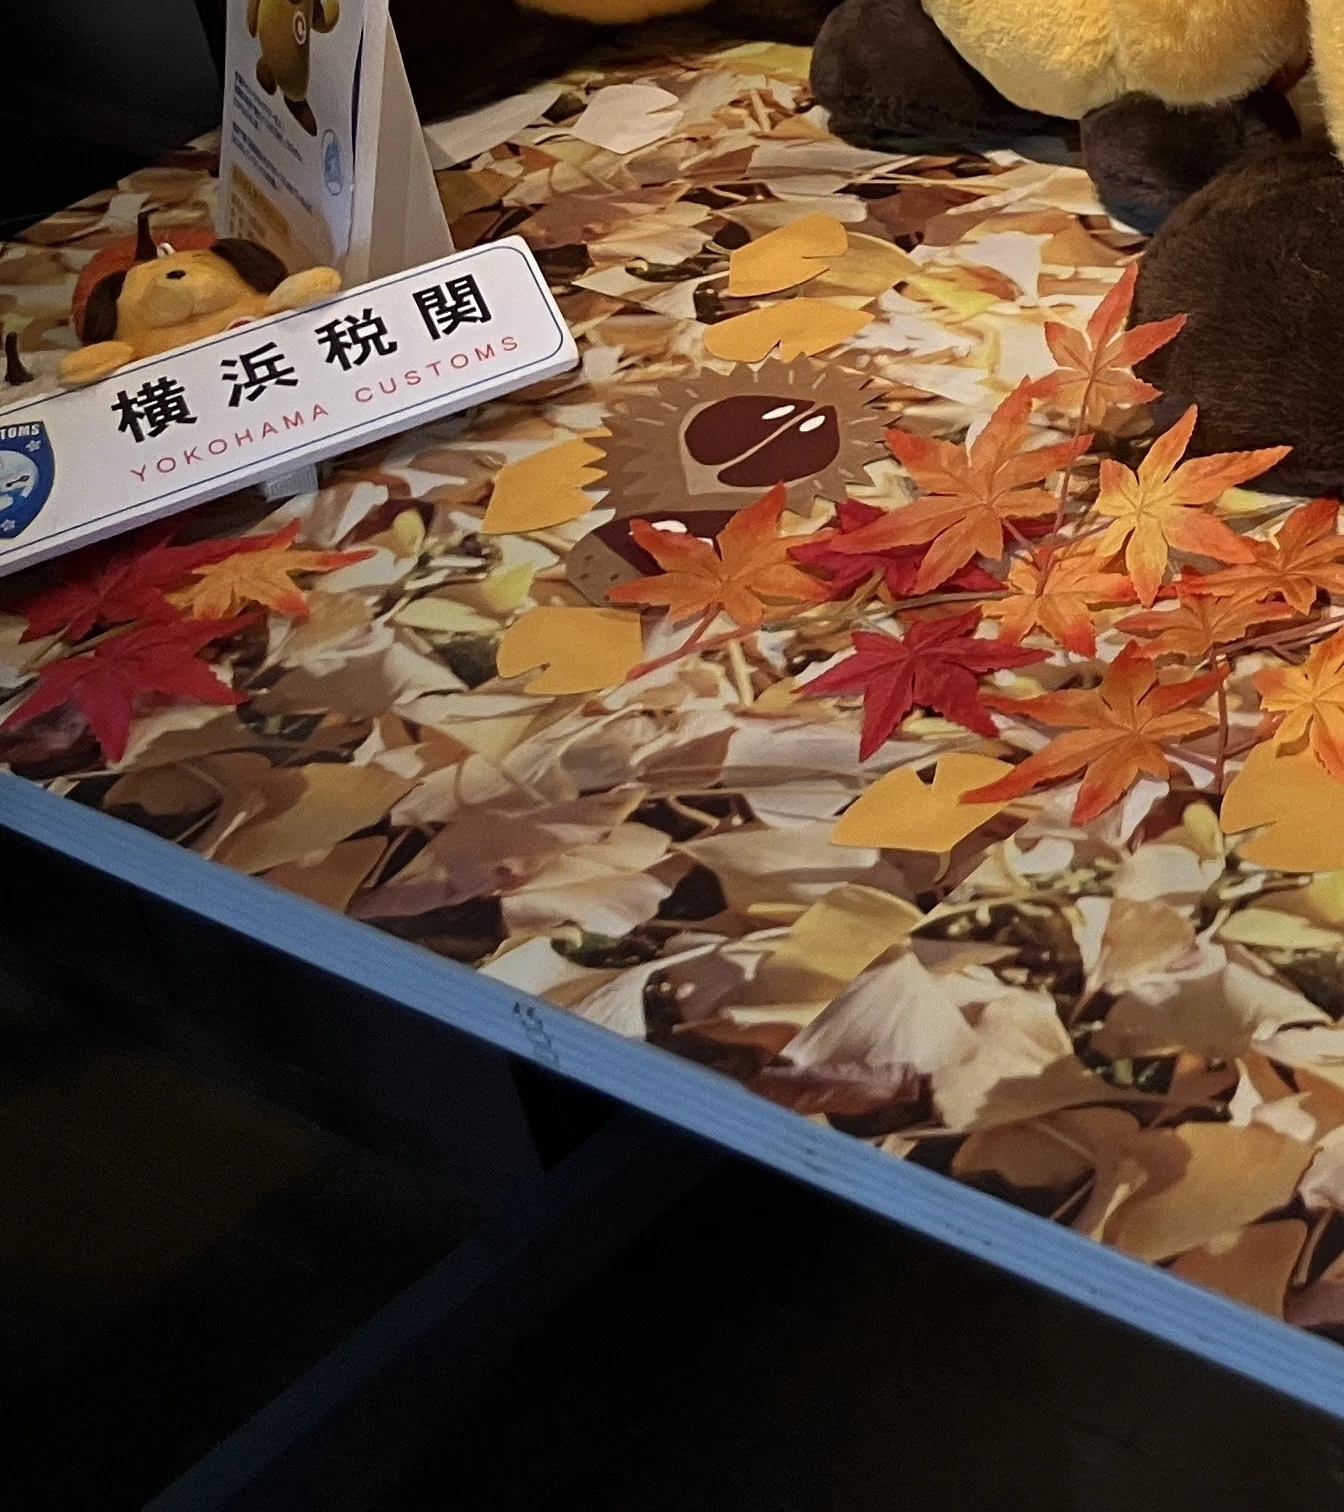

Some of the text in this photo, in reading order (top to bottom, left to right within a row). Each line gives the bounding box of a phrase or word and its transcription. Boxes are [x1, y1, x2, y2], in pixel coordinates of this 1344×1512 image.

[110, 274, 493, 444] 横浜税関
[130, 334, 522, 485] YOKOHAMA CUSTOMS
